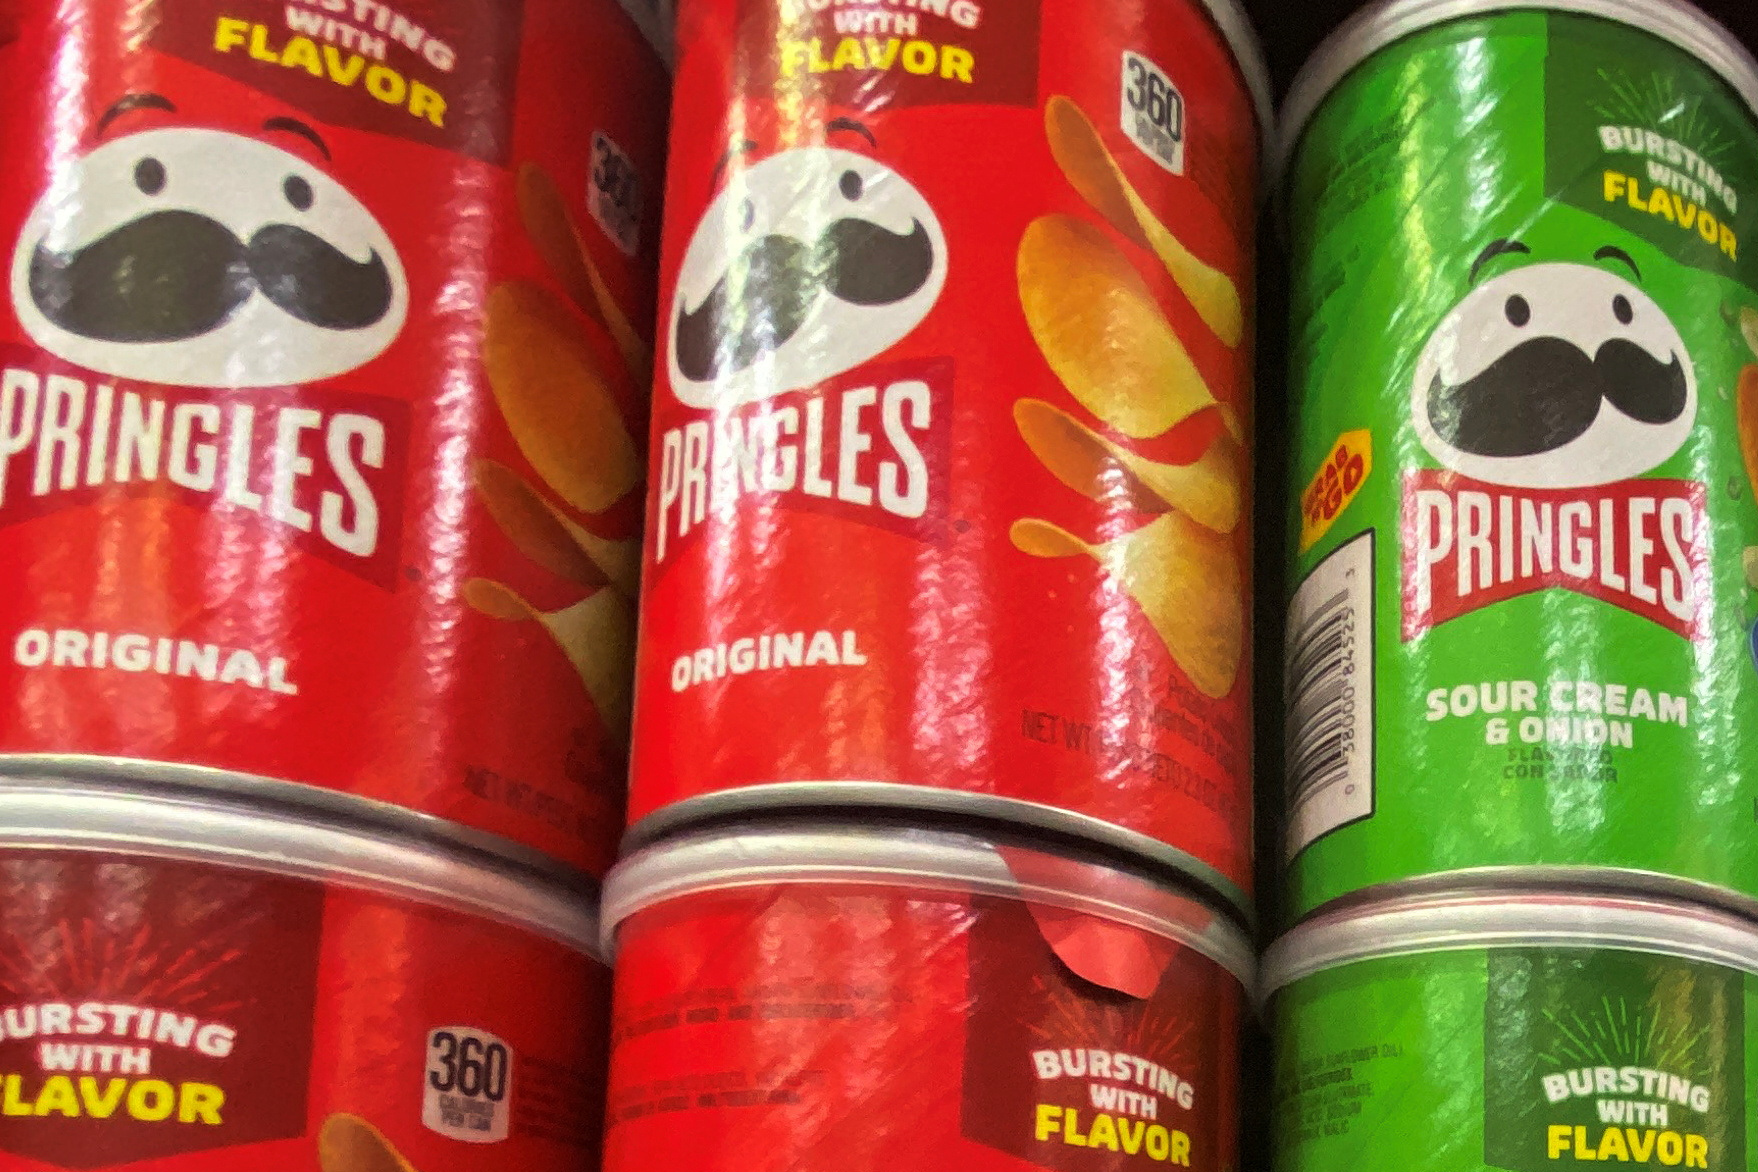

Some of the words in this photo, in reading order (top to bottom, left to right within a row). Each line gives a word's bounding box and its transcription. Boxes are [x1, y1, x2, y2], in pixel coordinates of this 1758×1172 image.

[284, 5, 386, 61] WITH
[834, 10, 918, 36] WITH
[213, 16, 448, 129] FLAVOR
[779, 36, 975, 84] FLAVOR
[1127, 58, 1183, 142] 360
[1598, 124, 1738, 215] BURSTING
[1645, 159, 1708, 207] WITH
[1603, 170, 1738, 262] FLAVOR
[0, 367, 385, 558] PRINGLES
[1414, 490, 1696, 622] PRINGLES
[14, 629, 299, 694] ORIGINAL
[671, 629, 868, 693] ORIGINAL
[1425, 680, 1538, 722] SOUR
[1549, 682, 1688, 728] CREAM
[1485, 717, 1510, 746] &
[1519, 717, 1634, 749] ONION
[0, 1002, 237, 1058] URSTING
[39, 1042, 151, 1074] WITH
[430, 1032, 507, 1102] 360
[1032, 1049, 1194, 1109] BURSTING
[1541, 1067, 1710, 1113] BURSTING
[0, 1075, 226, 1126] LAVOR
[1090, 1083, 1158, 1121] WITH
[1597, 1100, 1669, 1127] WITH
[1034, 1104, 1193, 1168] FLAVOR
[1547, 1125, 1708, 1168] FLAVOR
